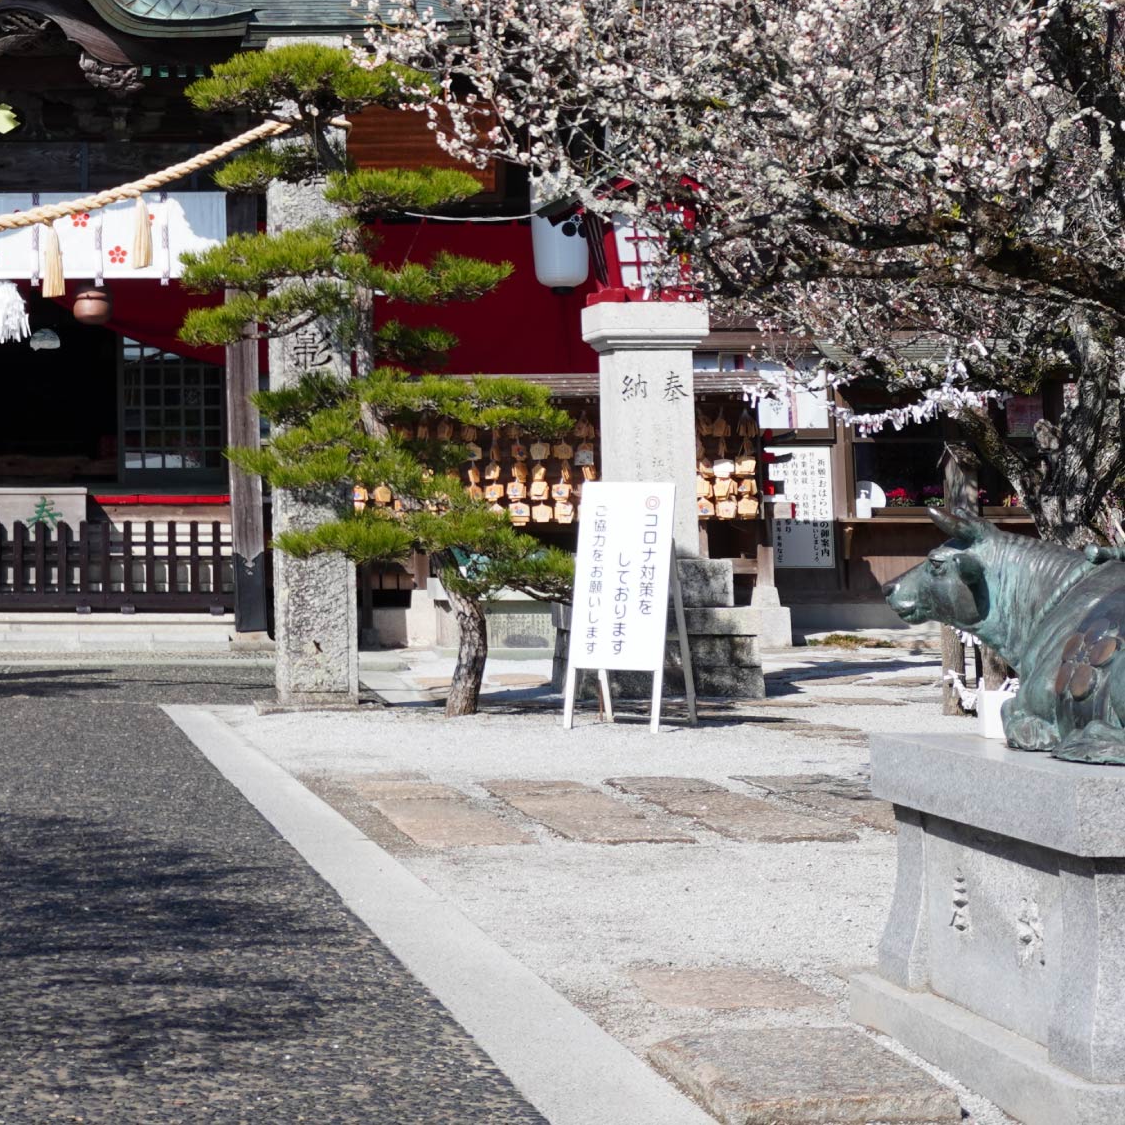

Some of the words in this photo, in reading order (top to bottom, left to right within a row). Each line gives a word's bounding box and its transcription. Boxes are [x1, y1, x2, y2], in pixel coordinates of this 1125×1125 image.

[585, 505, 608, 655] ご協力をお願いします
[611, 551, 631, 655] しております
[638, 513, 658, 615] コロナ対策を
